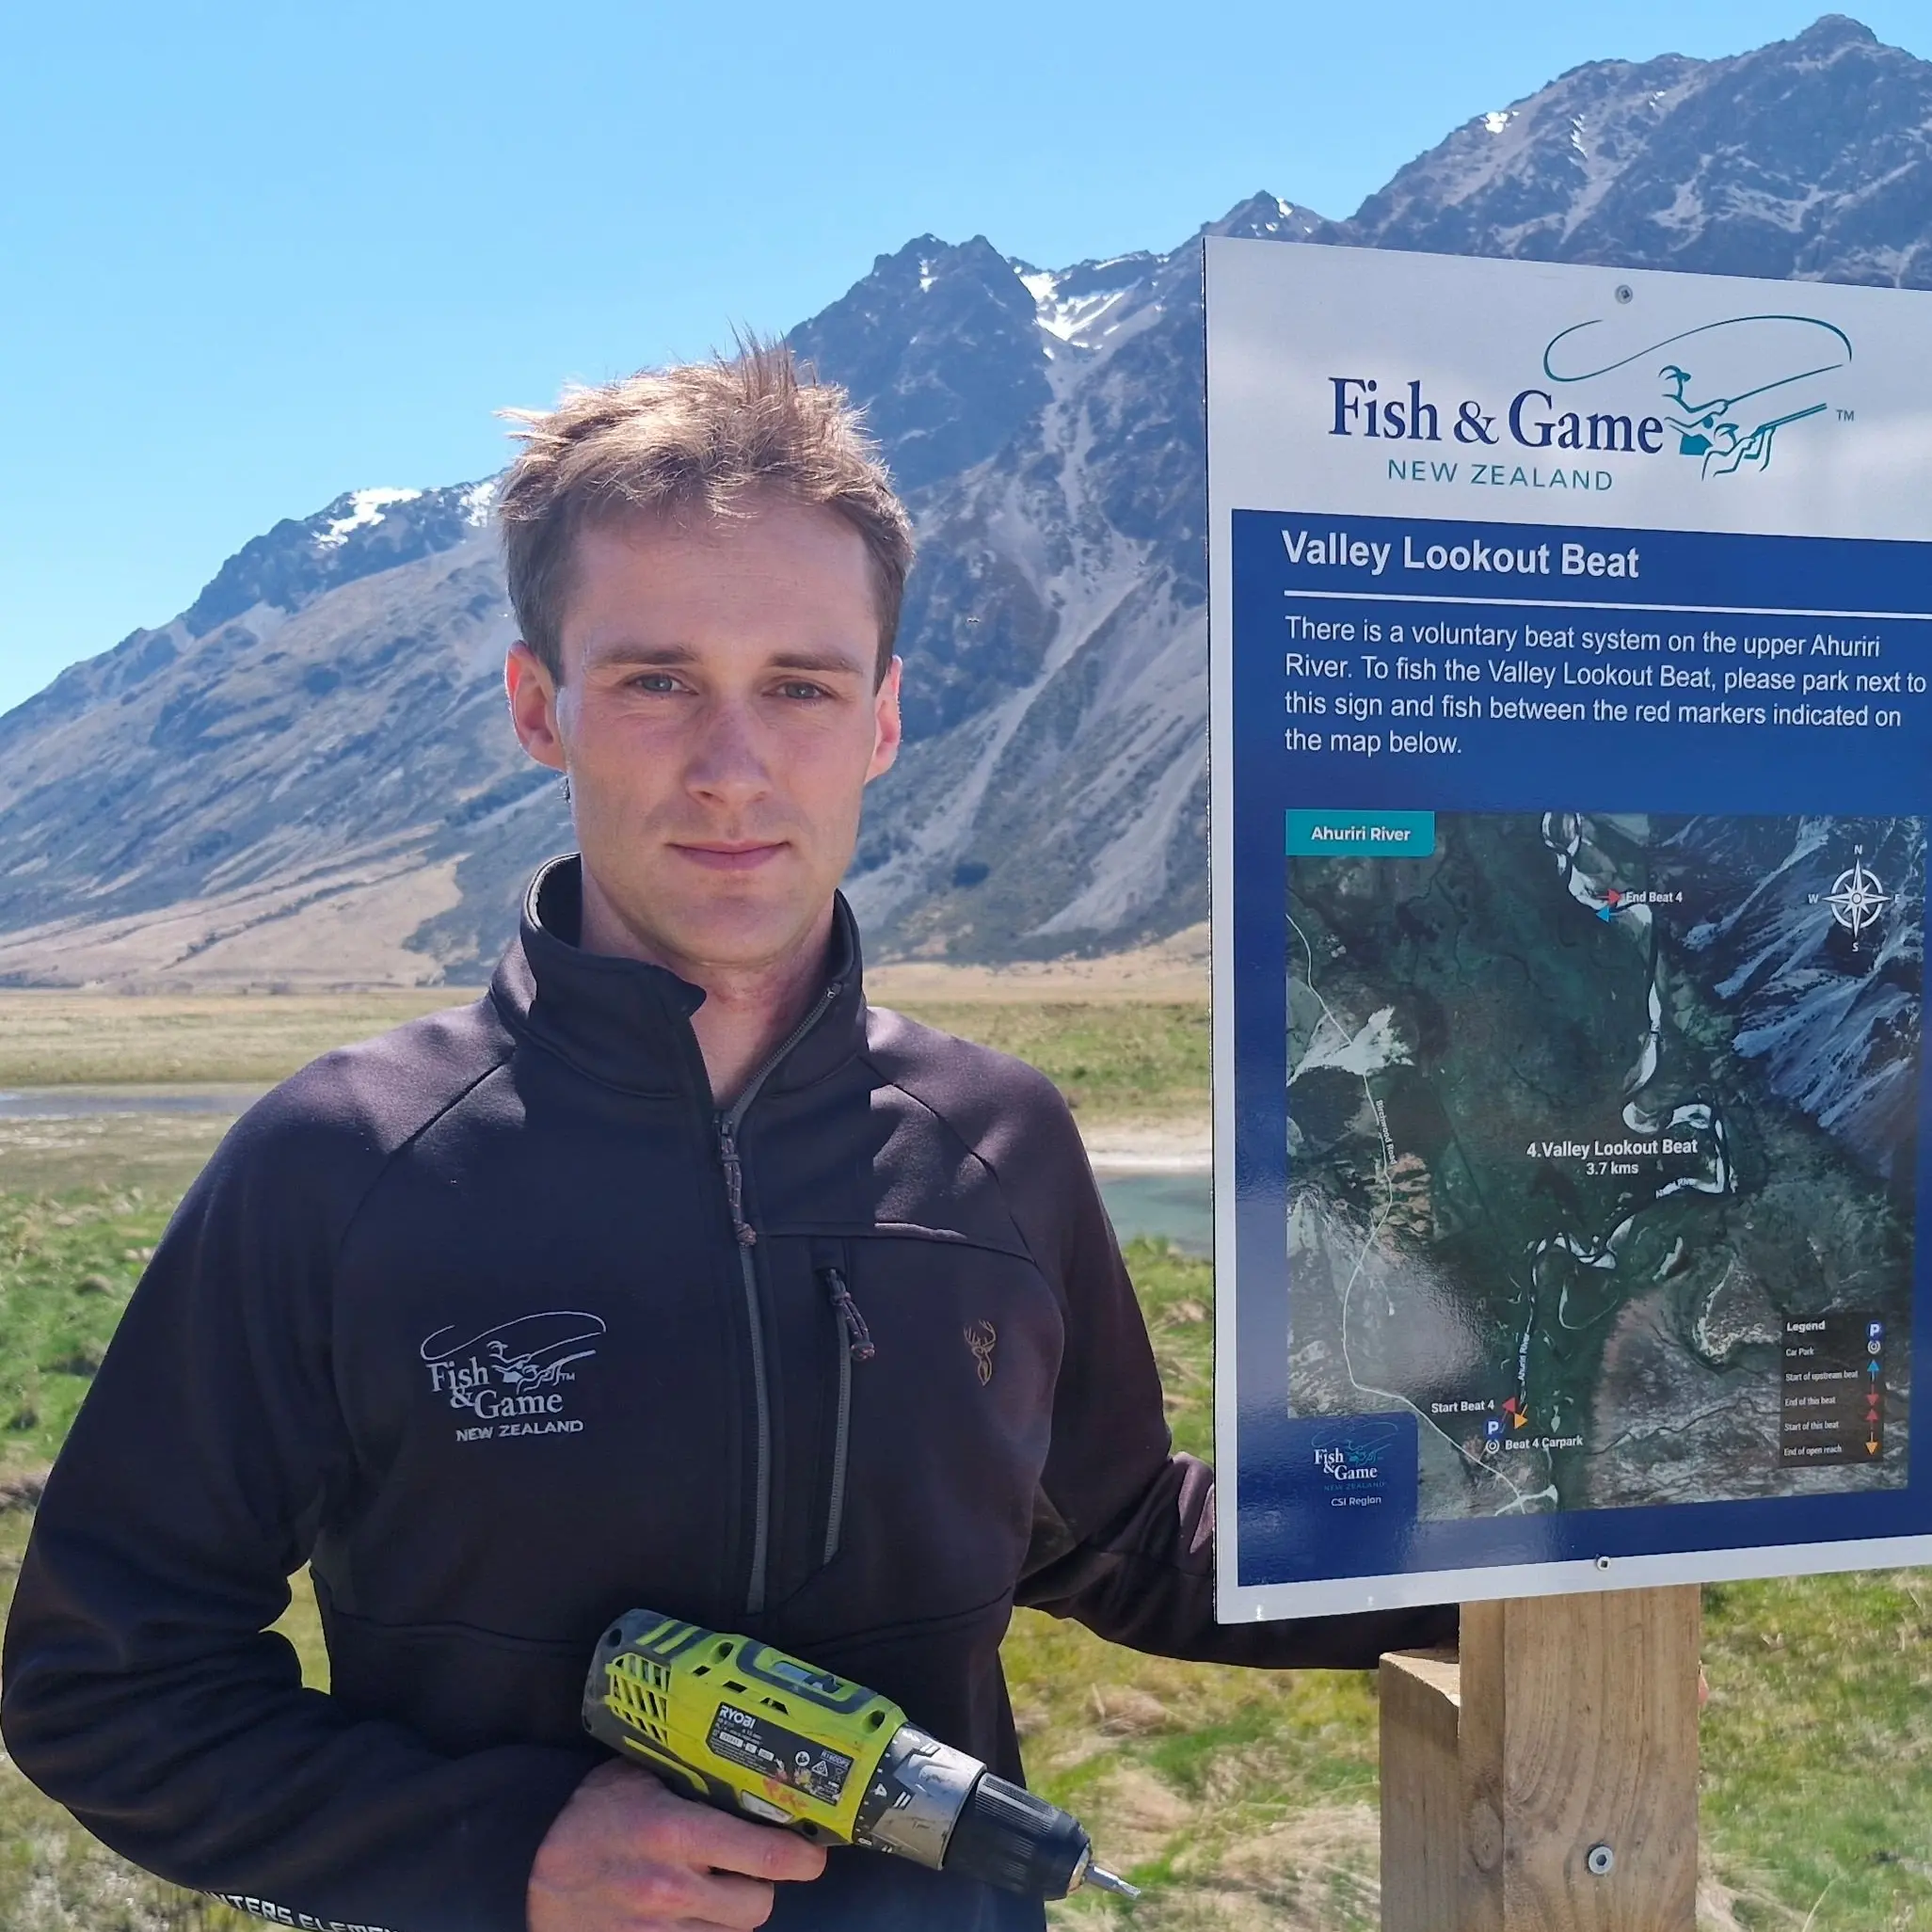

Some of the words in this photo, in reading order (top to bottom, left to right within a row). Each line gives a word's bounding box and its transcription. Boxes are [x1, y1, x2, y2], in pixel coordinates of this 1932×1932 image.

[1328, 376, 1442, 441] Fish
[1453, 401, 1500, 445] &
[1509, 389, 1664, 454] Game
[1388, 459, 1458, 482] NEW
[1471, 463, 1613, 490] ZEALAND
[1281, 530, 1391, 575] Valley
[1404, 536, 1550, 574] Lookout
[1560, 543, 1639, 579] Beat
[1285, 615, 1355, 641] There
[1364, 619, 1382, 643] is
[1389, 624, 1404, 643] a
[1412, 622, 1517, 651] voluntary
[1525, 625, 1574, 649] beat
[1581, 629, 1661, 655] system
[1668, 634, 1695, 653] on
[1702, 631, 1736, 653] the
[1744, 636, 1806, 659] upper
[1810, 634, 1881, 657] Ahuriri
[1285, 653, 1353, 678] River.
[1361, 655, 1389, 679] To
[1396, 657, 1436, 680] fish
[1444, 660, 1480, 681] the
[1488, 661, 1556, 689] Valley
[1564, 662, 1653, 687] Lookout
[1659, 664, 1716, 690] Beat,
[1724, 667, 1796, 693] please
[1802, 670, 1849, 695] park
[1856, 673, 1902, 693] next
[1907, 673, 1926, 694] to
[1285, 691, 1327, 715] this
[1334, 693, 1382, 721] sign
[1390, 695, 1433, 717] and
[1442, 695, 1481, 718] fish
[1490, 697, 1586, 720] between
[1593, 700, 1628, 722] the
[1635, 701, 1670, 723] red
[1678, 703, 1766, 725] markers
[1773, 703, 1869, 726] indicated
[1875, 710, 1902, 726] on
[1285, 728, 1322, 751] the
[1331, 734, 1381, 757] map
[1389, 730, 1462, 754] below.
[1311, 826, 1365, 840] Ahuriri
[1370, 826, 1411, 841] River
[1853, 844, 1862, 855] N
[1626, 891, 1646, 902] End
[1649, 891, 1673, 902] Beat
[1675, 891, 1684, 902] 4
[1852, 942, 1860, 952] S
[1594, 1140, 1658, 1157] Lookout
[1662, 1139, 1698, 1155] Beat
[1587, 1161, 1607, 1175] 3.7
[1611, 1161, 1639, 1175] kms
[1786, 1319, 1826, 1333] Legend
[1786, 1348, 1797, 1357] Car
[1798, 1347, 1814, 1356] Park
[426, 1356, 491, 1392] Fish
[1786, 1373, 1802, 1382] Start
[1803, 1371, 1811, 1381] of
[1812, 1371, 1843, 1382] upstream
[1844, 1370, 1859, 1379] beat
[450, 1386, 475, 1409] &
[473, 1389, 565, 1419] Game
[1430, 1402, 1458, 1414] Start
[1461, 1400, 1485, 1413] Beat
[1488, 1399, 1495, 1411] 4
[1784, 1397, 1797, 1407] End
[1798, 1397, 1806, 1406] of
[1807, 1397, 1820, 1405] this
[1820, 1396, 1836, 1405] beat
[455, 1427, 494, 1442] NEW
[498, 1420, 584, 1438] ZEALAND
[1784, 1422, 1801, 1431] Start
[1802, 1421, 1810, 1430] of
[1824, 1420, 1839, 1429] beat
[1505, 1439, 1530, 1450] Beat
[1532, 1438, 1540, 1448] 4
[1541, 1435, 1583, 1448] Carpark
[1314, 1447, 1344, 1465] Fish
[1784, 1447, 1797, 1457] End
[1797, 1446, 1805, 1455] of
[1806, 1446, 1823, 1457] open
[1323, 1462, 1334, 1474] &
[1334, 1464, 1378, 1480] Game
[1331, 1497, 1347, 1507] CSI
[1349, 1495, 1381, 1507] Region
[719, 1704, 756, 1729] RYOBI
